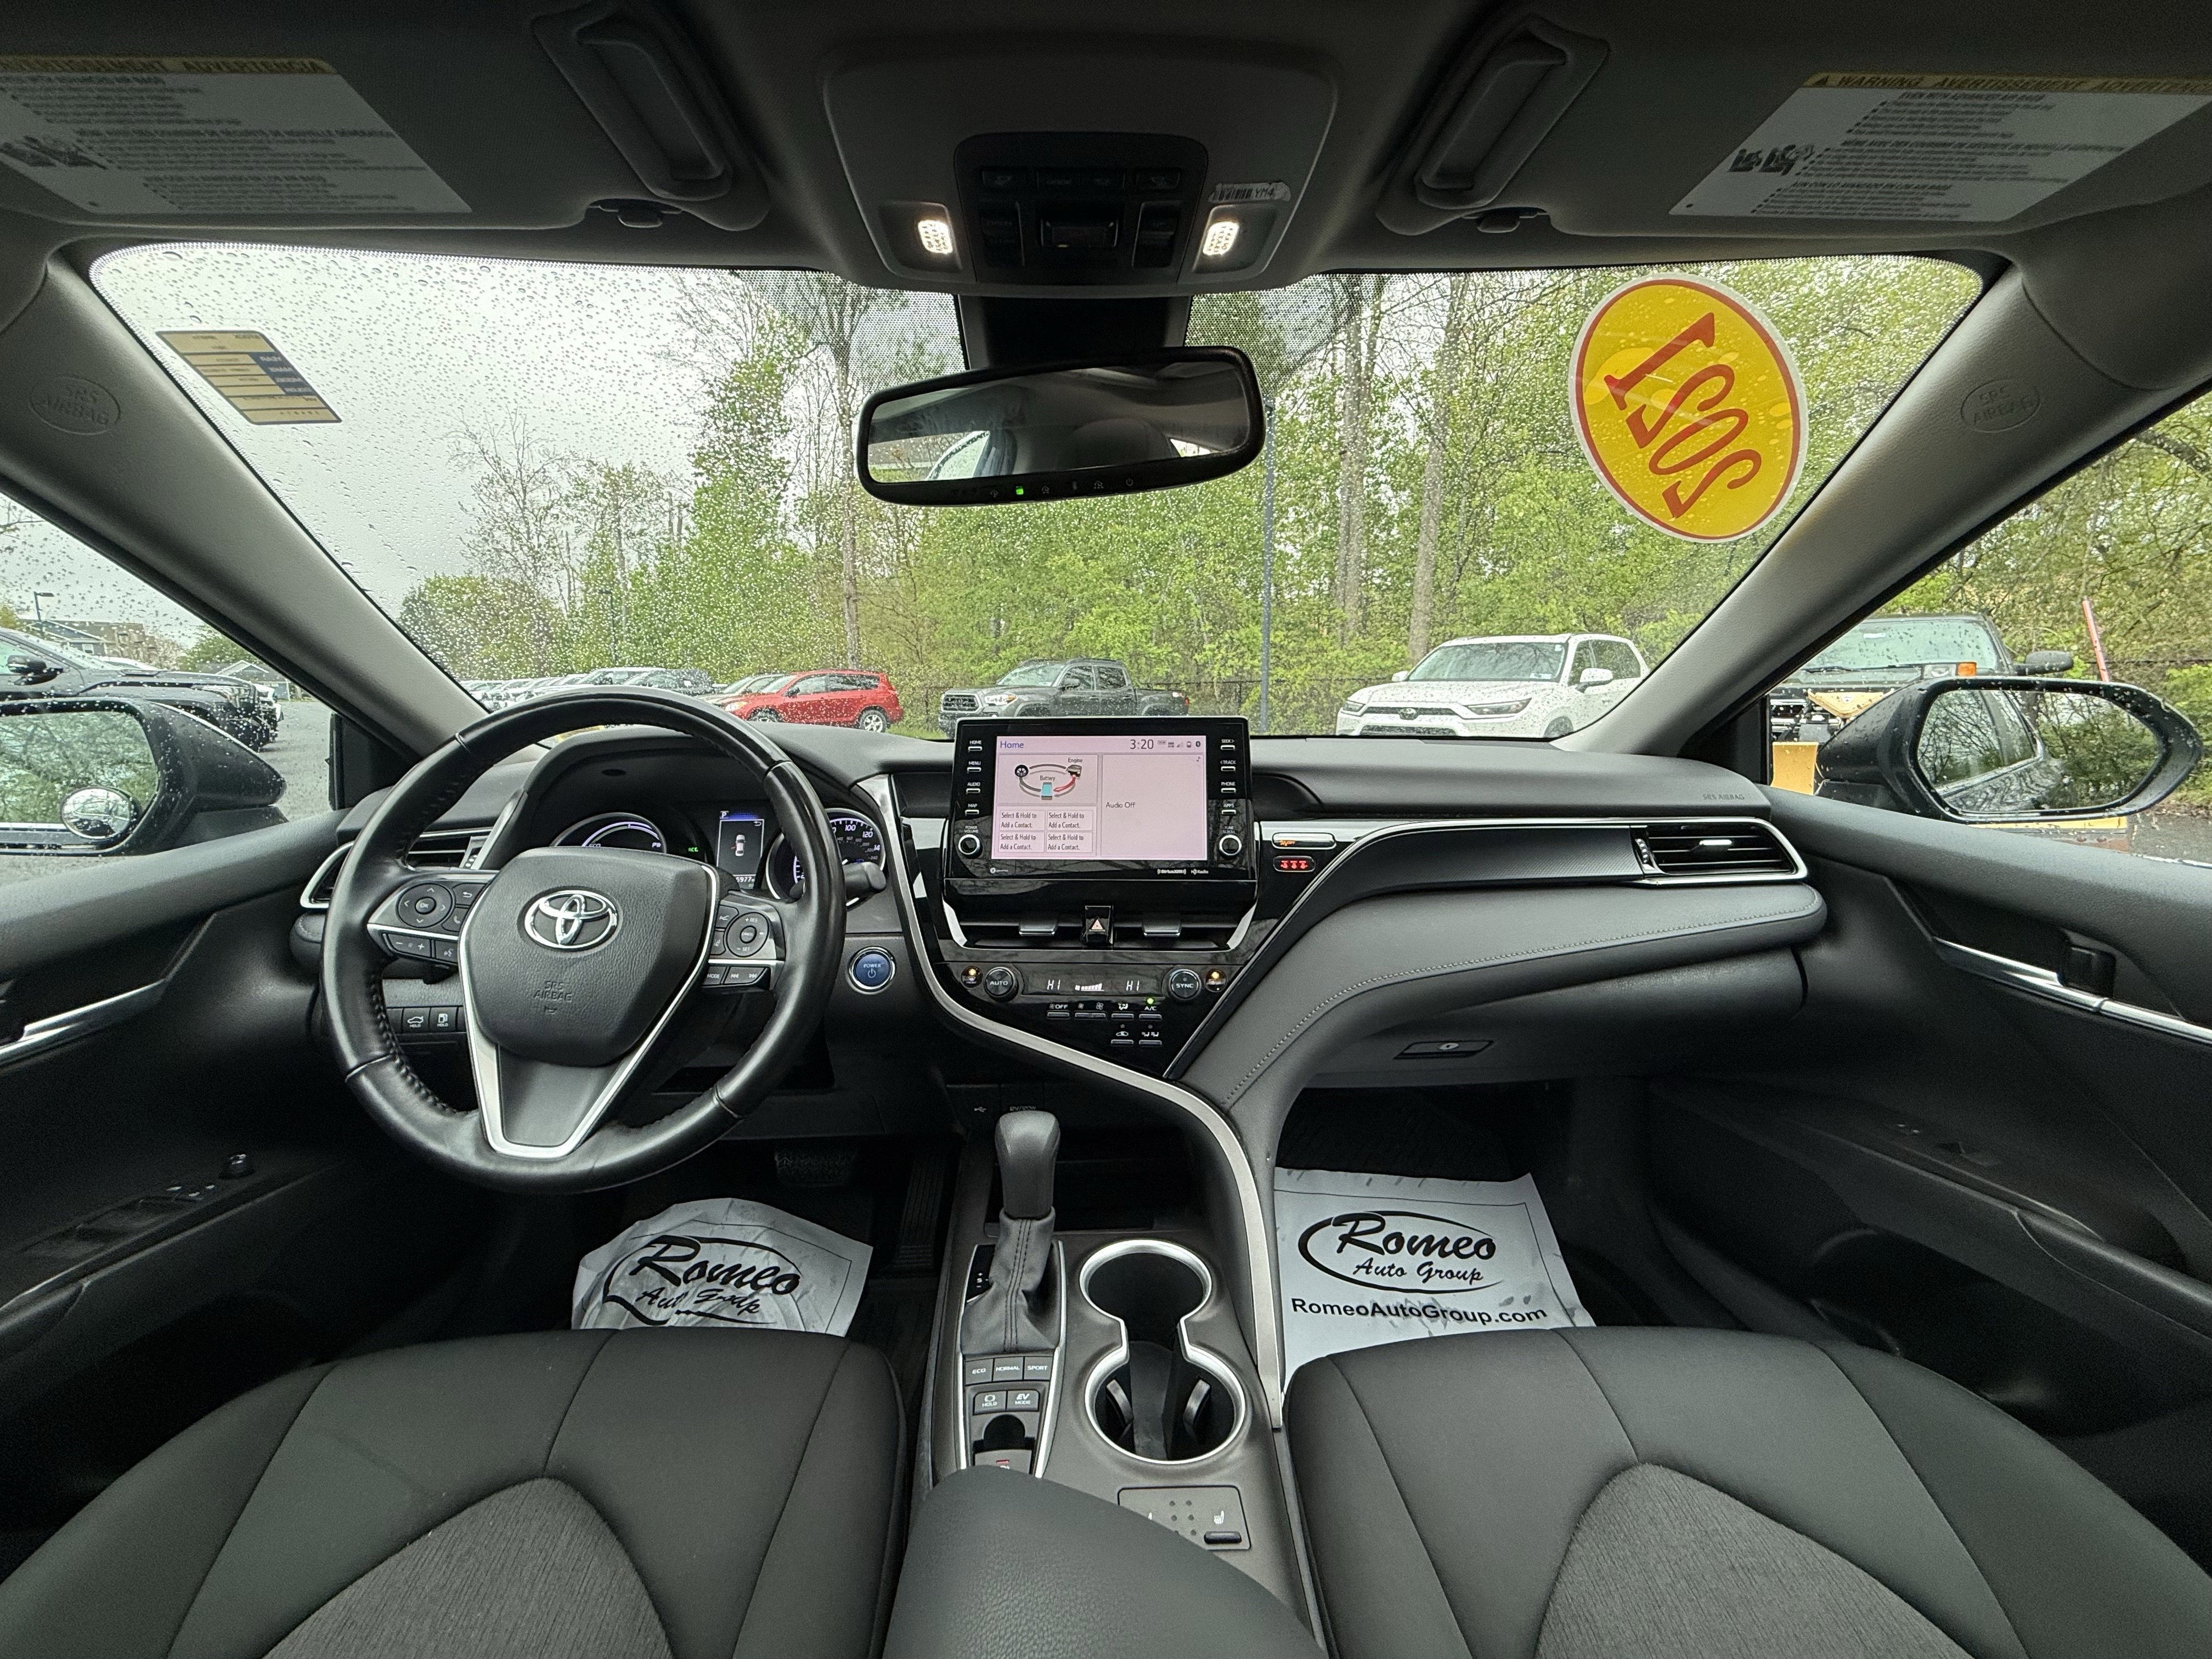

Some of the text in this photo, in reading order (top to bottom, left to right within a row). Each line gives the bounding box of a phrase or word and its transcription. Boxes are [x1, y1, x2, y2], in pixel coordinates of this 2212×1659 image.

[1130, 739, 1154, 749] 3:20
[533, 990, 572, 1001] AIRBAG
[1331, 1212, 1496, 1260] Romeo
[629, 1235, 800, 1295] Romeo
[1353, 1257, 1484, 1285] Auto Group
[1291, 1298, 1548, 1325] RomeoAutoGroup.com
